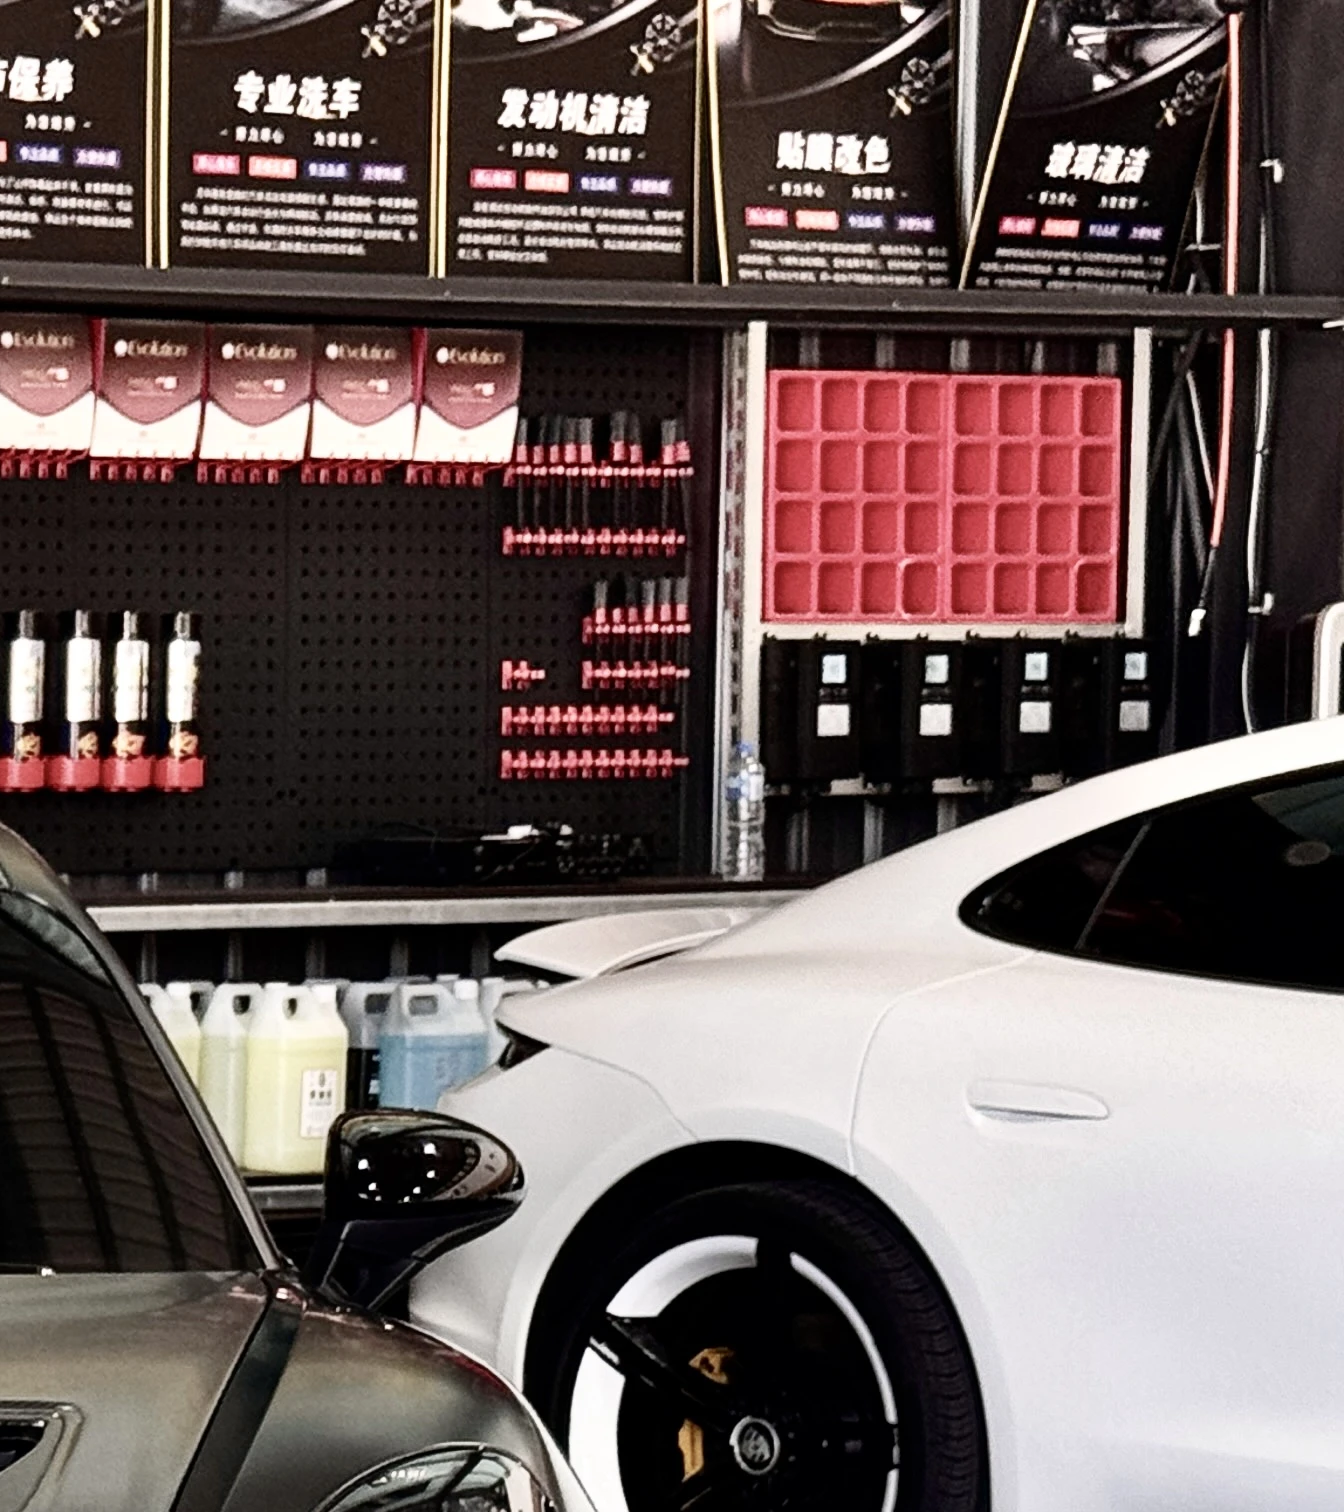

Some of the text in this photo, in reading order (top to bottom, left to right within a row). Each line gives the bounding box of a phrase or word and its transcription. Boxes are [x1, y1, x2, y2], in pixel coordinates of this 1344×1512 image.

[233, 69, 363, 119] 专业洗车
[497, 87, 650, 135] 发动机清洁
